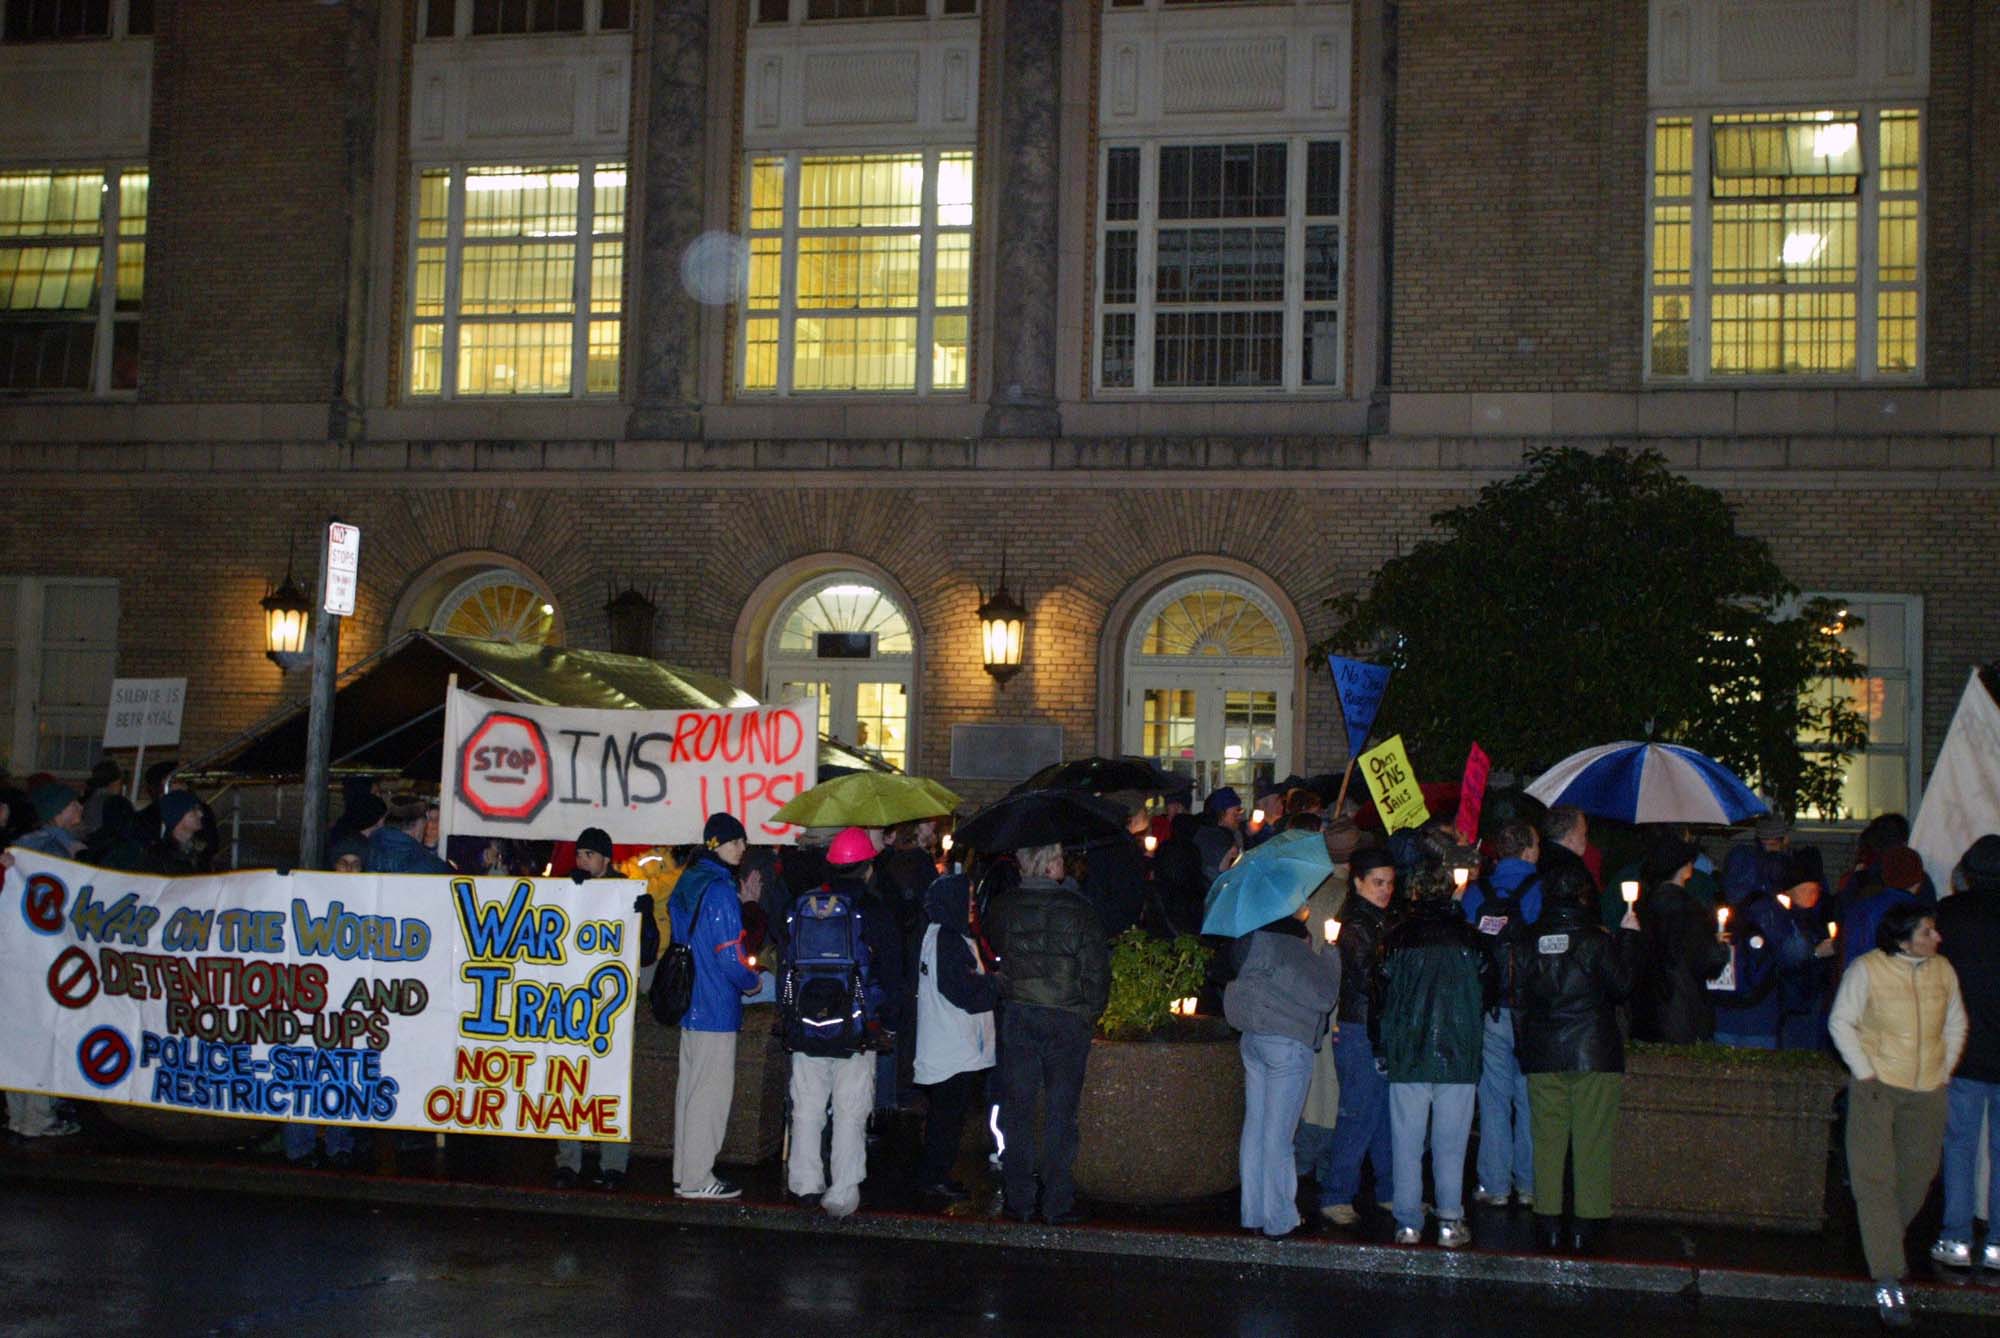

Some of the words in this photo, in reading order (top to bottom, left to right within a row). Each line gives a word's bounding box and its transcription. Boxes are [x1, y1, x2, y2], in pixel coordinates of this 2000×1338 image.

[473, 746, 536, 774] STOP
[670, 710, 804, 765] ROUND
[1376, 764, 1405, 794] INS
[70, 886, 160, 946] WAR
[162, 907, 215, 951] ON
[217, 909, 286, 953] THE
[292, 898, 431, 961] WORLD
[451, 878, 569, 964] WAR
[576, 921, 624, 955] ON
[100, 951, 329, 1010] DETENTIONS
[343, 977, 429, 1016] AND
[460, 961, 632, 1057] IRAQ?
[166, 1002, 390, 1051] ROUND-UPS
[140, 1031, 382, 1083] POLICE-STATE
[454, 1047, 535, 1092] NOT
[545, 1055, 590, 1096] IN
[152, 1069, 399, 1121] RESTRICTIONS
[425, 1086, 508, 1129] OUR
[517, 1092, 621, 1136] NAME
